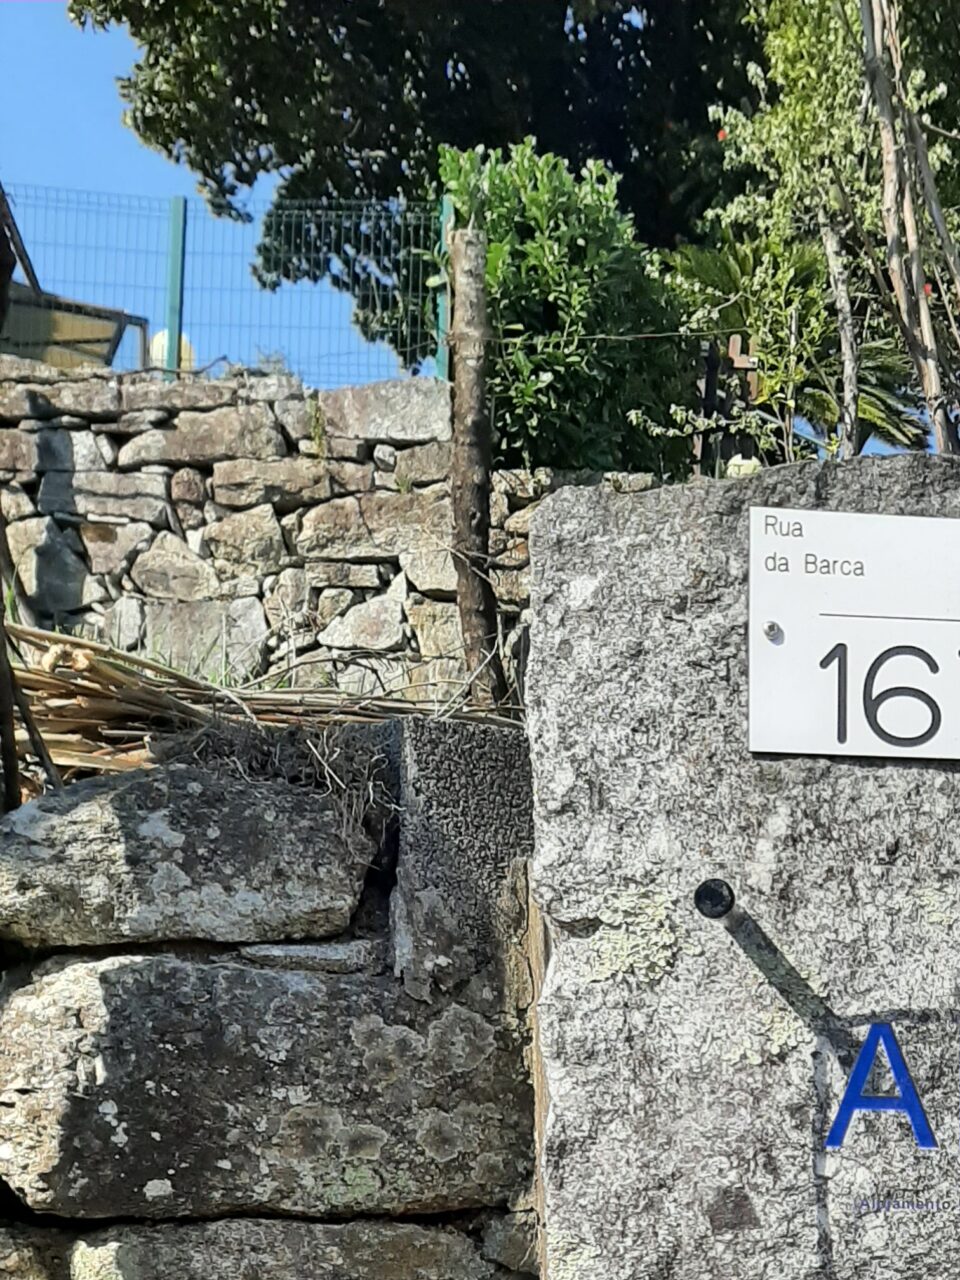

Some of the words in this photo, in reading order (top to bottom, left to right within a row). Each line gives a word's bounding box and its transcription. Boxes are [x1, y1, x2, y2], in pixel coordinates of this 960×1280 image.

[763, 514, 804, 538] Rua
[763, 551, 790, 573] da
[804, 553, 866, 577] Barca
